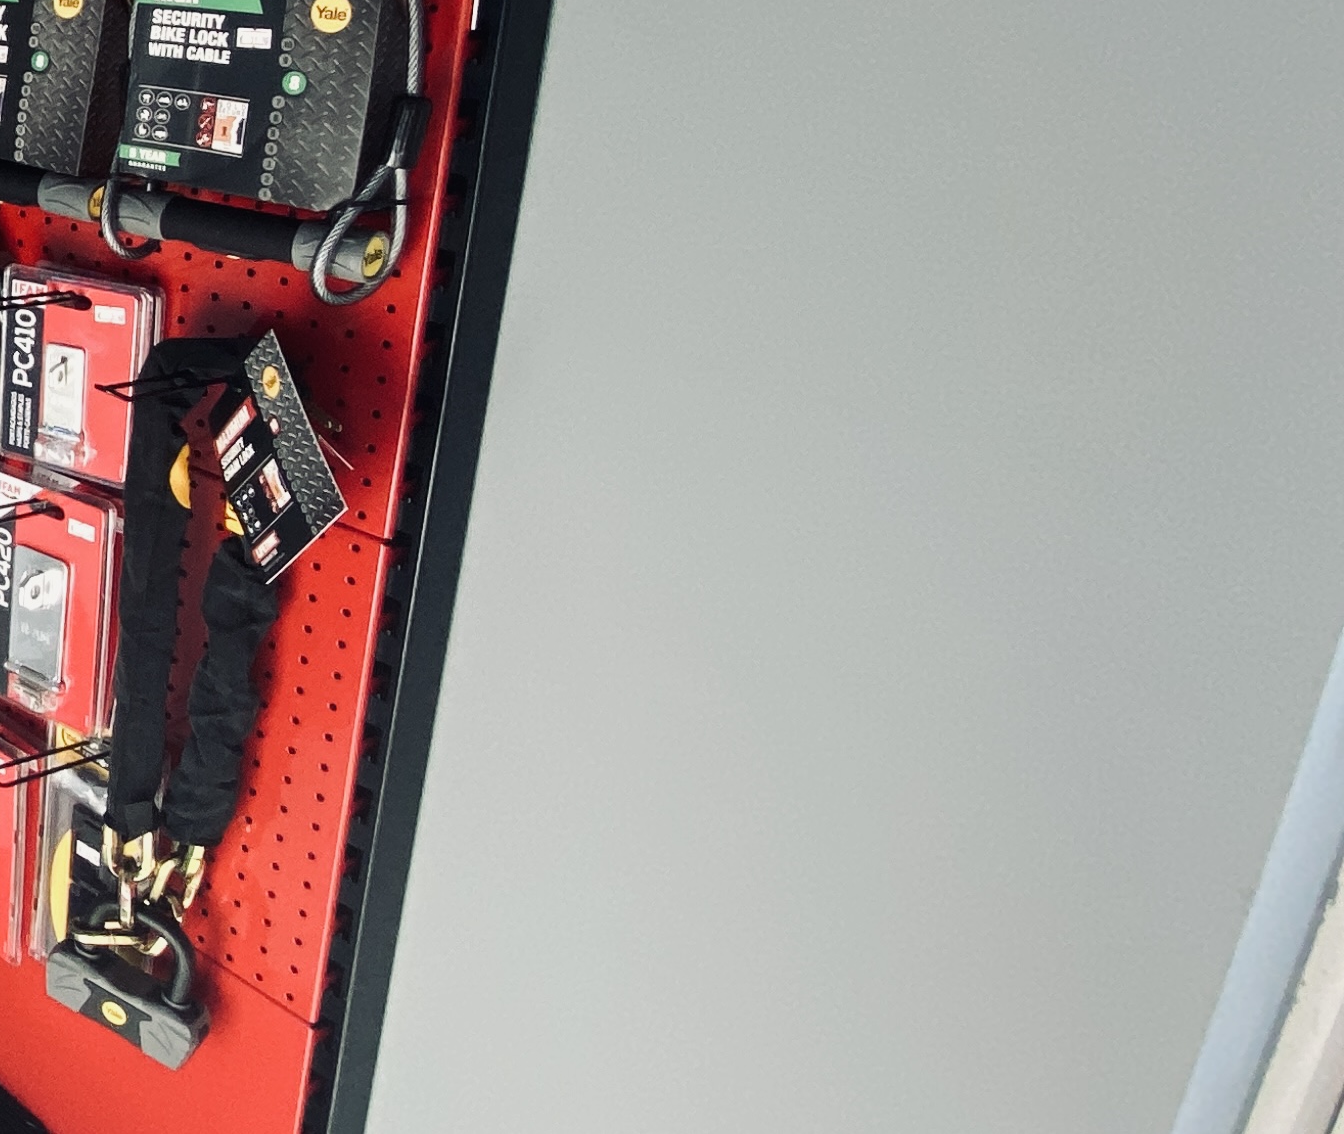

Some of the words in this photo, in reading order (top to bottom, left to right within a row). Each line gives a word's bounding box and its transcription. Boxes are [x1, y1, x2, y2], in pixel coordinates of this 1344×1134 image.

[152, 8, 226, 30] SECURITY
[316, 5, 348, 22] Yale
[150, 25, 186, 43] BIKE
[189, 29, 230, 48] LOCK
[148, 41, 183, 59] WITH
[186, 46, 231, 65] CABLE
[139, 149, 166, 164] YEAR
[12, 309, 37, 388] PC410
